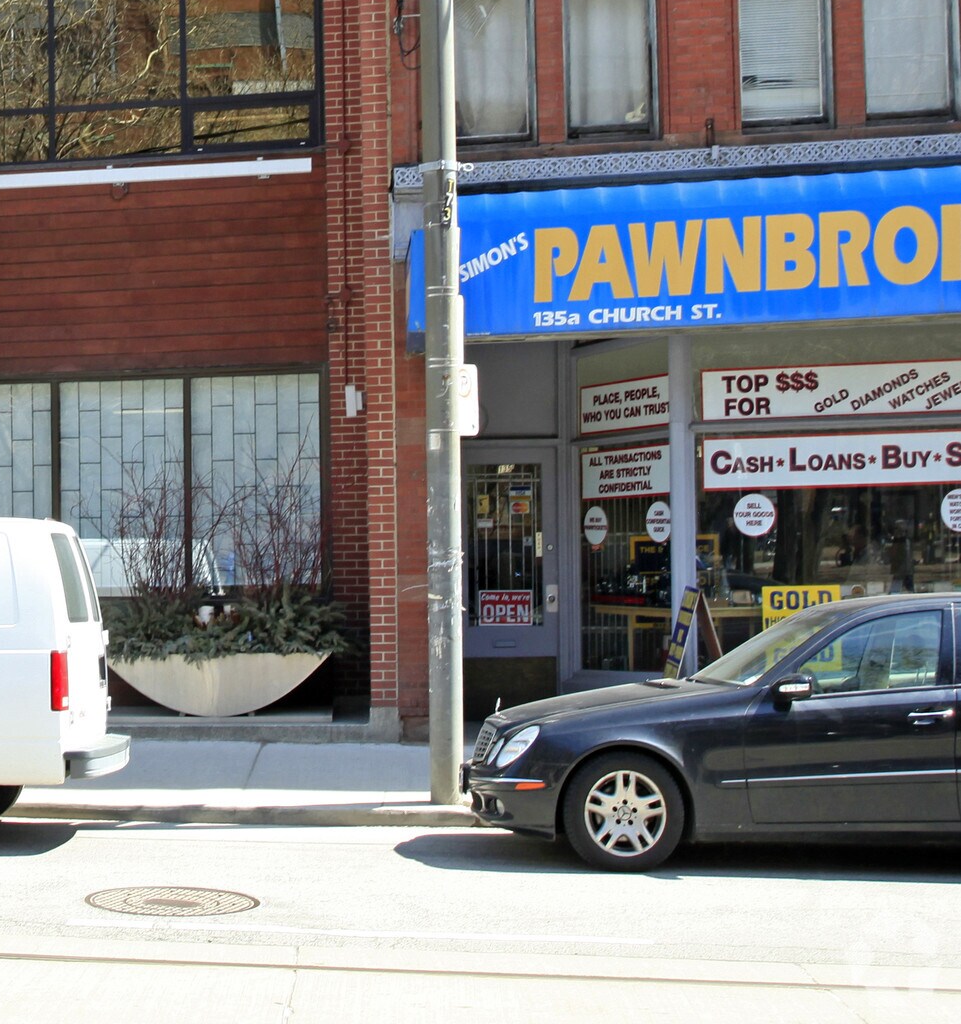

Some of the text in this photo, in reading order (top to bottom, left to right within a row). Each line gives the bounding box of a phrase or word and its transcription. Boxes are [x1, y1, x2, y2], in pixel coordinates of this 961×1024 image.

[459, 232, 529, 283] SIMON'S
[533, 304, 722, 327] 135a CHURCH ST.
[722, 370, 819, 394] TOP $$$
[850, 368, 919, 412] DIAMONDS
[888, 371, 951, 410] WATCHES
[593, 386, 660, 406] PLACE, PEOPLE,
[814, 388, 850, 413] GOLD
[925, 381, 961, 410] JEWE
[583, 401, 670, 423] WHO YOU CAN TRUST
[724, 397, 771, 416] FOR
[589, 450, 662, 467] ALL TRANSACTIONS
[599, 465, 652, 480] ARE STRICTLY
[598, 480, 653, 494] CONFIDENTIAL
[481, 593, 500, 601] Come
[770, 590, 833, 610] GOLD
[482, 604, 529, 623] OPEN
